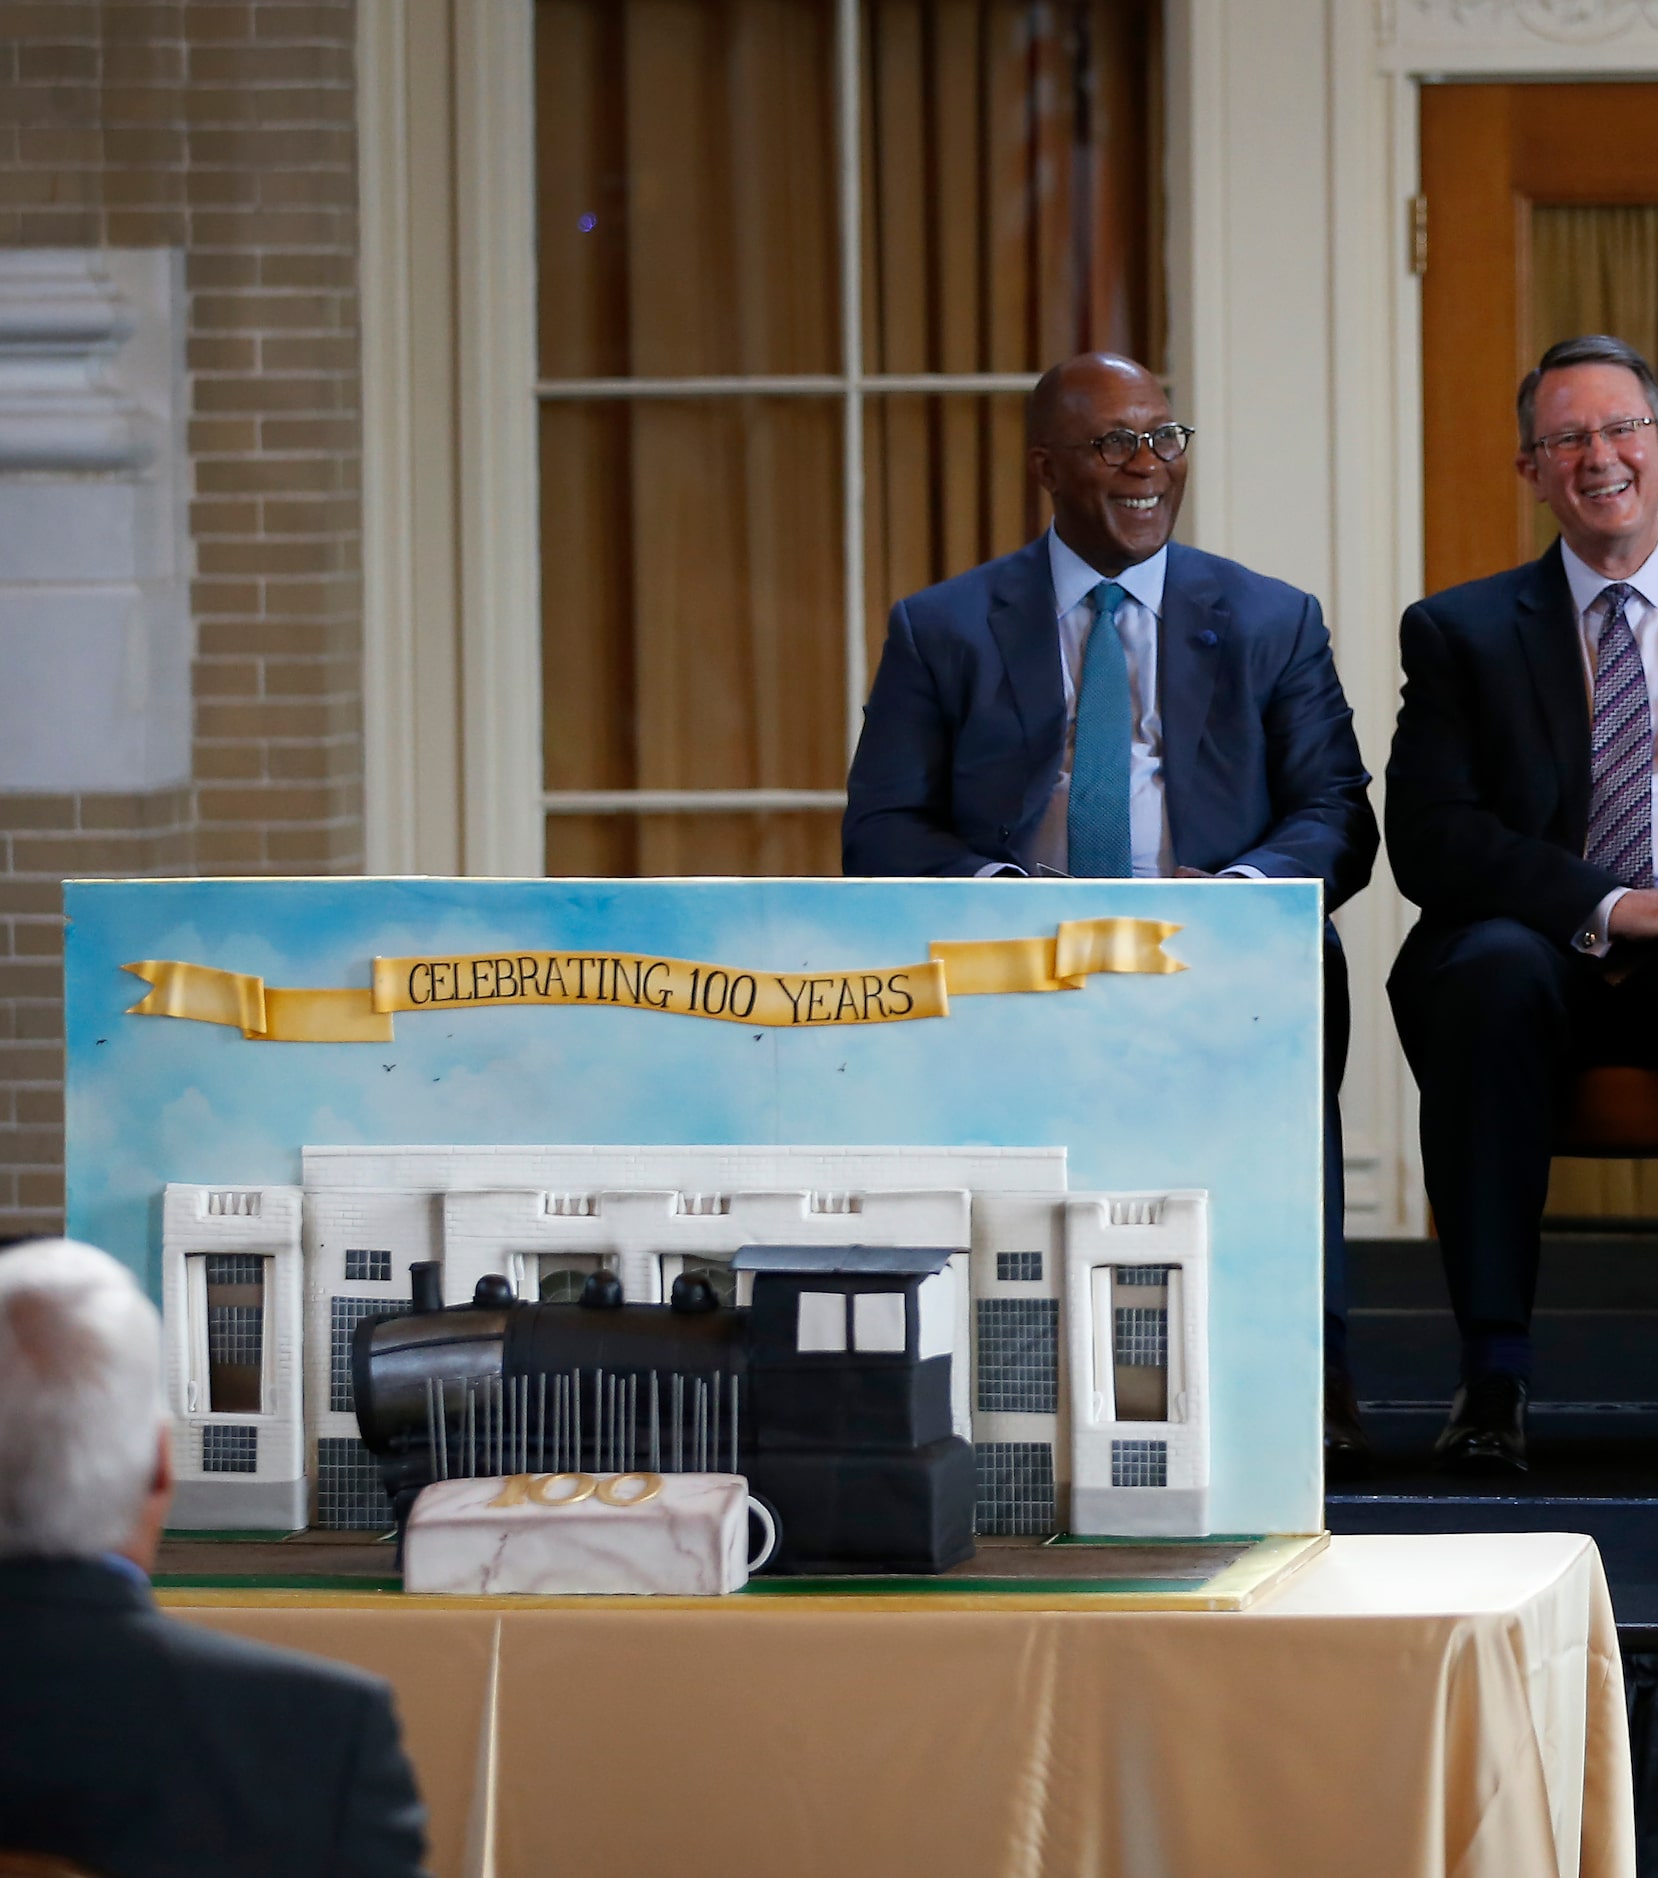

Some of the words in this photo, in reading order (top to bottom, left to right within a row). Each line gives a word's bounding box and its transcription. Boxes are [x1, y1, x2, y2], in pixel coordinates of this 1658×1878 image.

[408, 956, 673, 1006] CELEBRATING
[688, 968, 758, 1018] 100
[774, 973, 914, 1024] YEARS
[486, 1472, 664, 1508] 100
